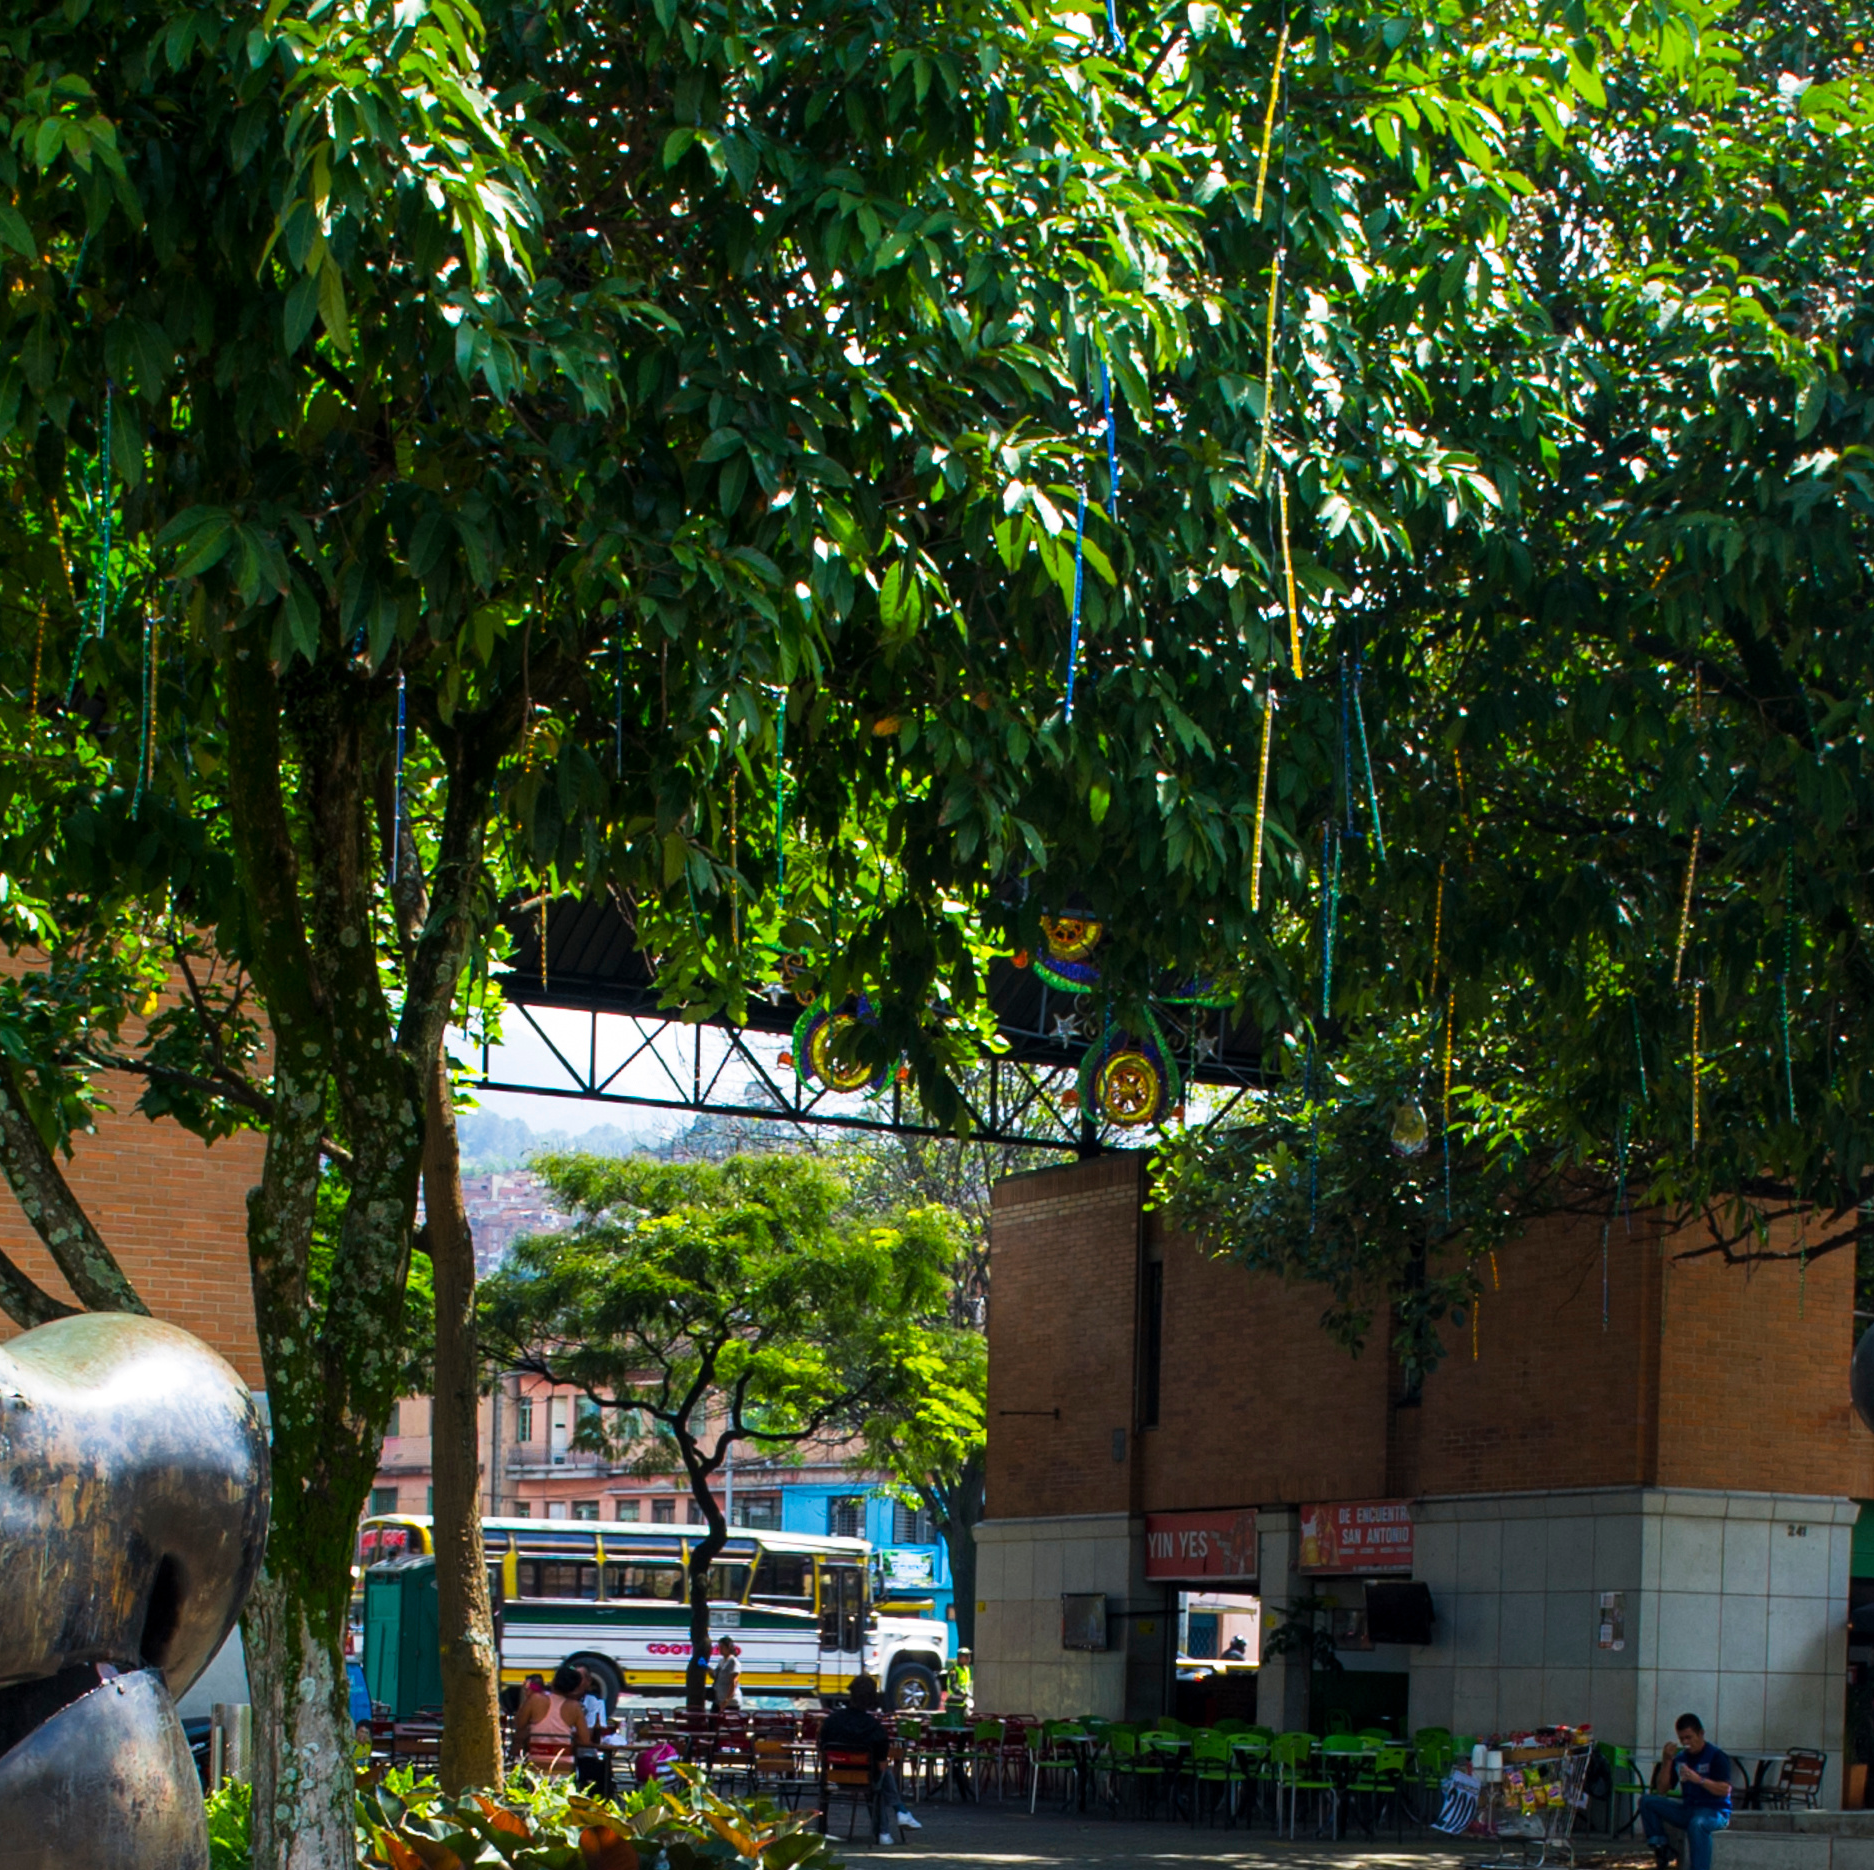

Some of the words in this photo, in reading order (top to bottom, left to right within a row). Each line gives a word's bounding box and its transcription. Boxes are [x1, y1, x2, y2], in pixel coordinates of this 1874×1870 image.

[1338, 1507, 1351, 1524] DE
[1147, 1531, 1173, 1559] YIN
[1179, 1530, 1208, 1558] YES
[1342, 1528, 1361, 1545] SAN
[1366, 1526, 1410, 1544] ANTONIO
[1436, 1786, 1476, 1833] 200
